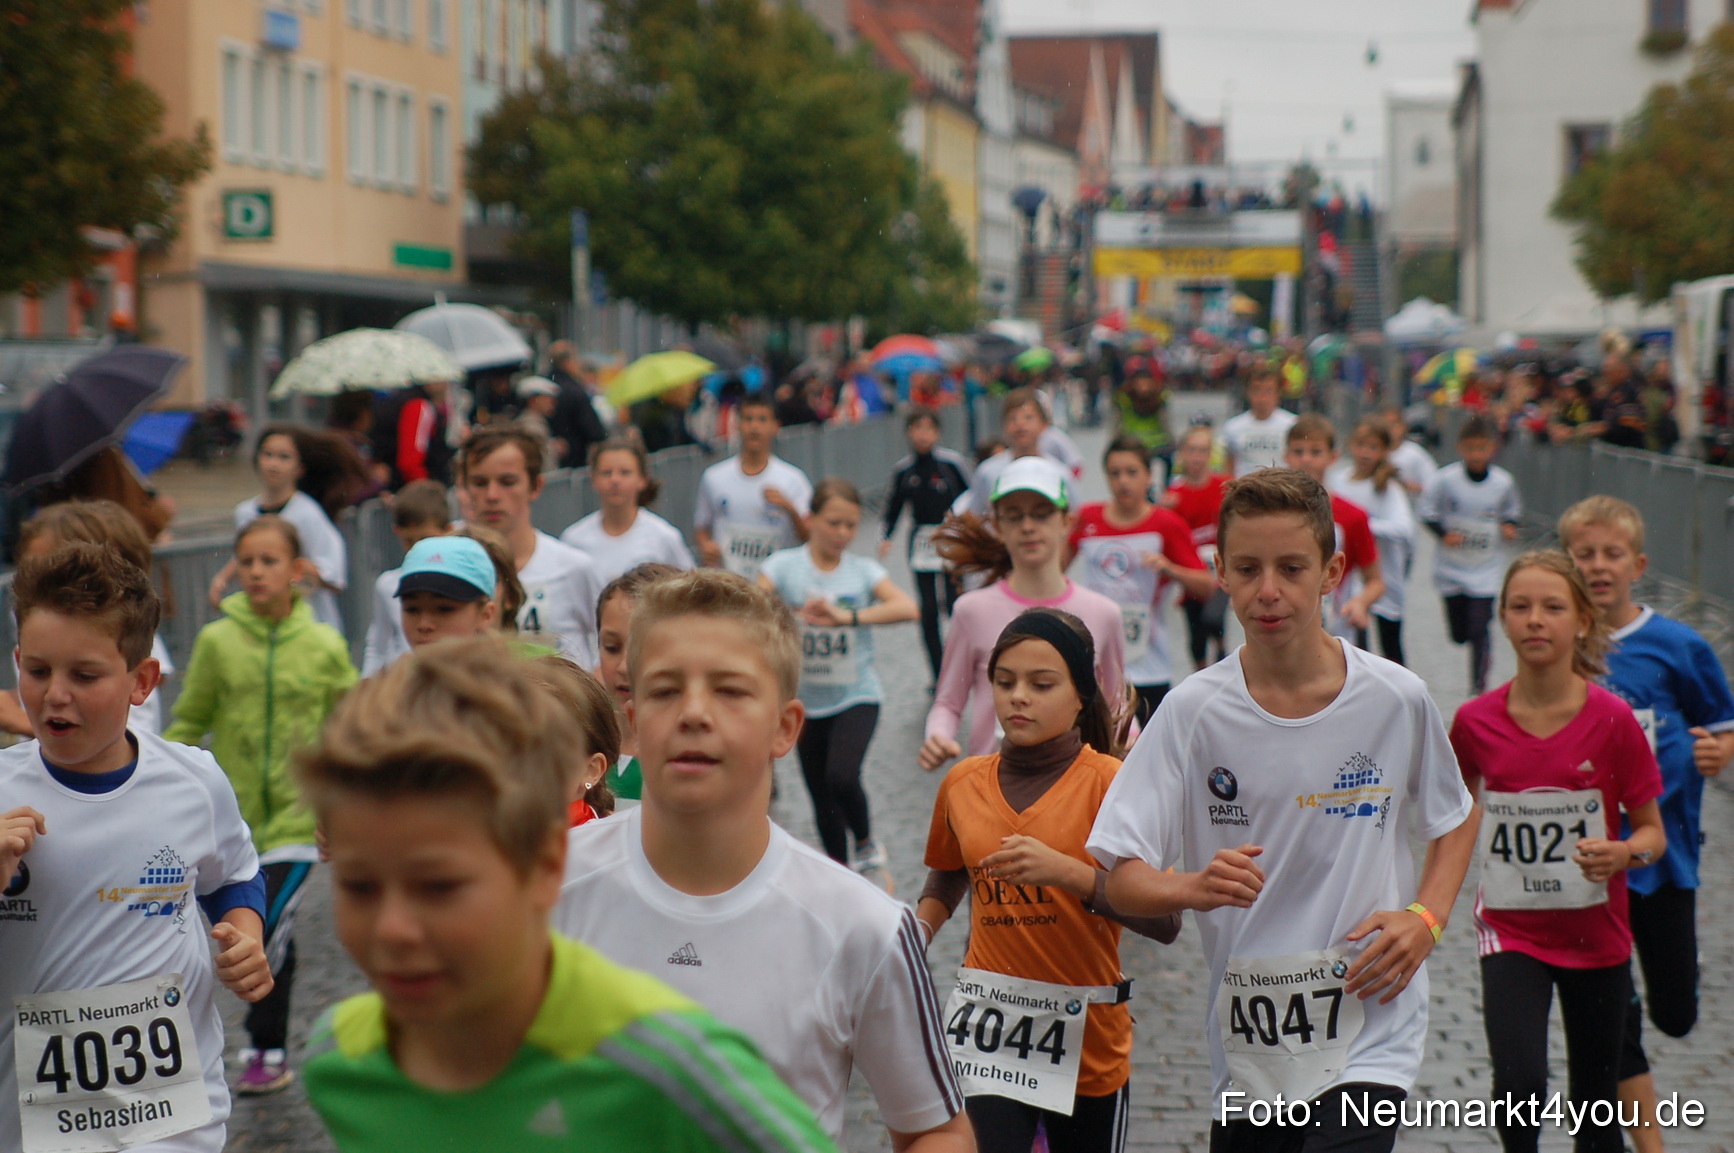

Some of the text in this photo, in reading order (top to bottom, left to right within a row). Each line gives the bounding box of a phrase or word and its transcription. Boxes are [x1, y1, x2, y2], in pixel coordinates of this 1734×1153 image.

[229, 195, 270, 236] D
[1208, 804, 1248, 817] PARTL
[1295, 793, 1322, 809] 14.
[1518, 804, 1579, 817] Neumarkt
[1211, 816, 1249, 826] Neumarkt
[1522, 876, 1562, 892] Luca
[96, 887, 125, 903] 14.
[1014, 914, 1057, 926] VISION
[667, 957, 702, 966] adidas
[1250, 967, 1326, 987] Neumarkt
[989, 988, 1059, 1011] Neumarkt
[18, 995, 159, 1026] PARTL Neumarkt
[1230, 987, 1343, 1046] 4047
[946, 1002, 1066, 1065] 4044
[36, 1017, 182, 1093] 4039
[956, 1060, 1038, 1089] Michelle
[57, 1099, 173, 1134] Sebastian
